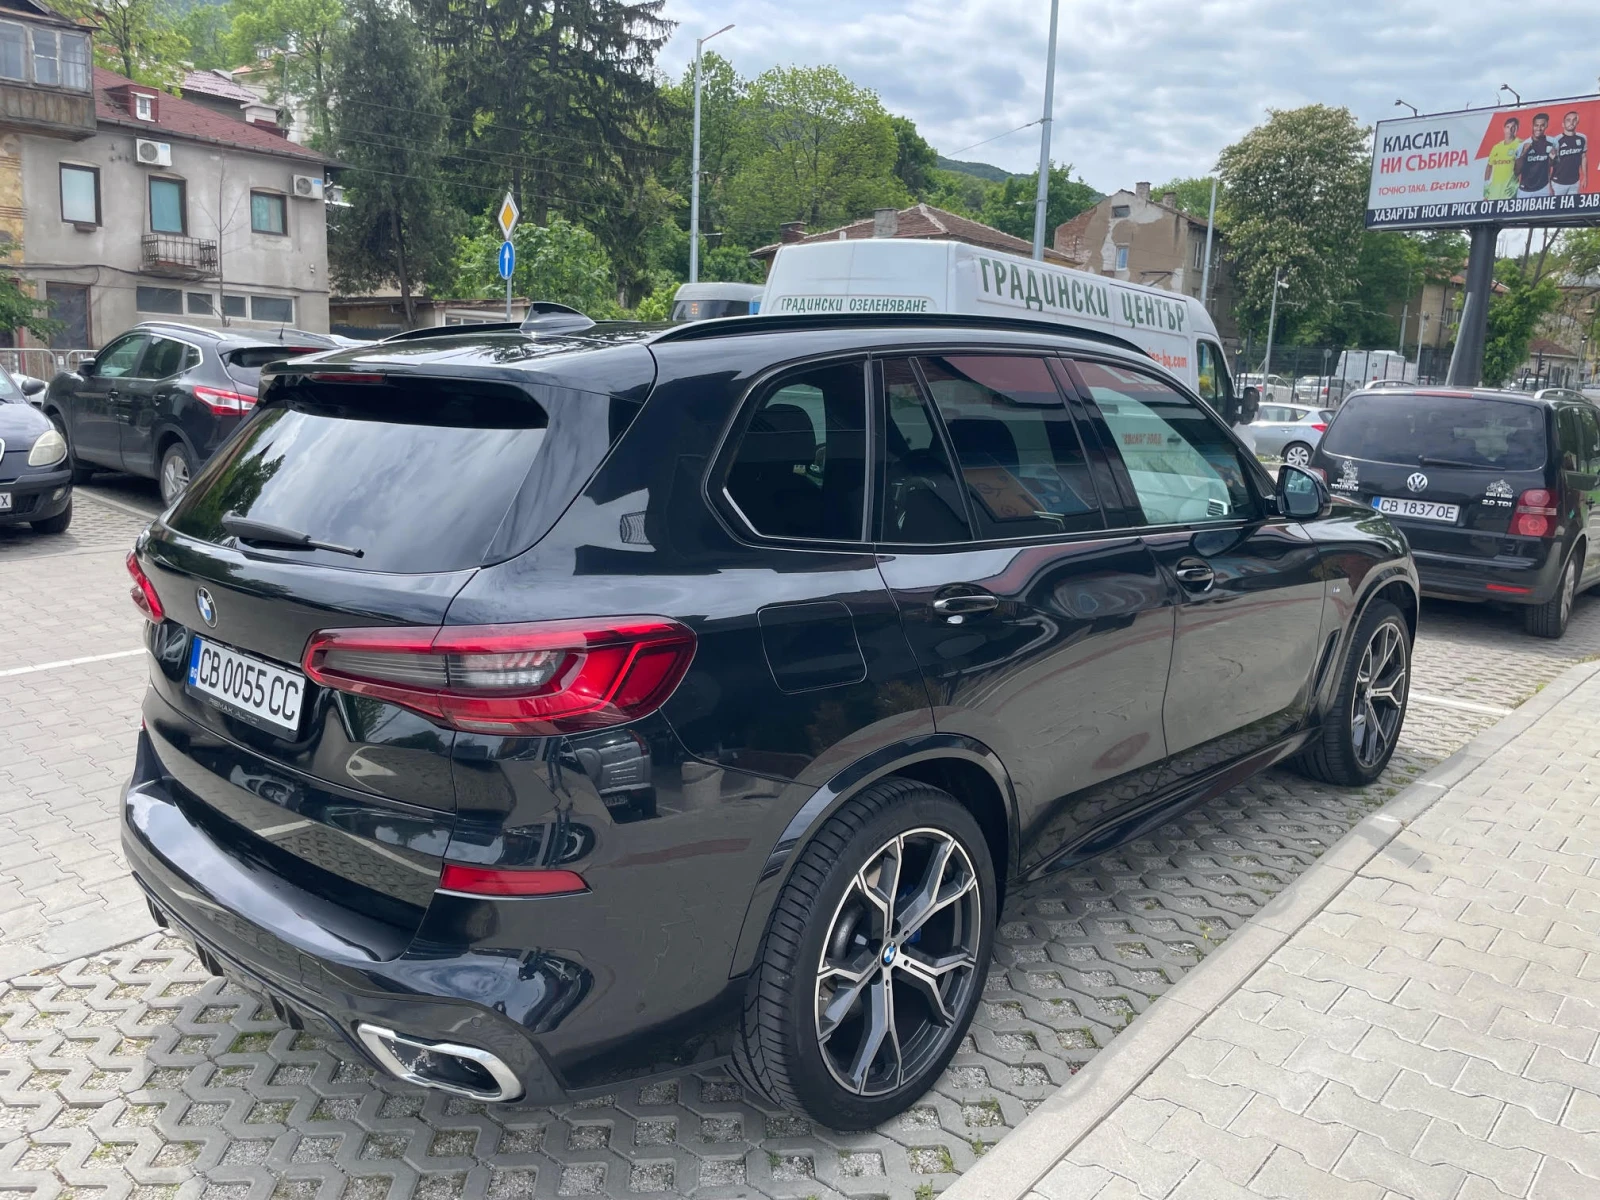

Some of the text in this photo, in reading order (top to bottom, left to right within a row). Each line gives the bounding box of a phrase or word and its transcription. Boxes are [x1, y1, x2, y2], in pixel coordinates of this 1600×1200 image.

[1383, 130, 1449, 153] КЛАСАТА
[1380, 149, 1469, 174] НИ СЪБИРА
[1378, 183, 1428, 196] ТОЧНО ТАКА.
[1430, 181, 1470, 192] Betano
[1373, 193, 1600, 222] ХАЗАРТЪТ НОСИ РИСК ОТ РАЗВИВАНЕ НА ЗАВ
[781, 296, 928, 313] ГРАДИНСКИ ОЗЕЛЕНЯВАНЕ
[979, 257, 1185, 332] ГРАДИНСКИ ЦЕНТЪР
[1380, 499, 1398, 512] CB
[1403, 501, 1435, 516] 1837
[200, 647, 299, 721] CB 0055 CC
